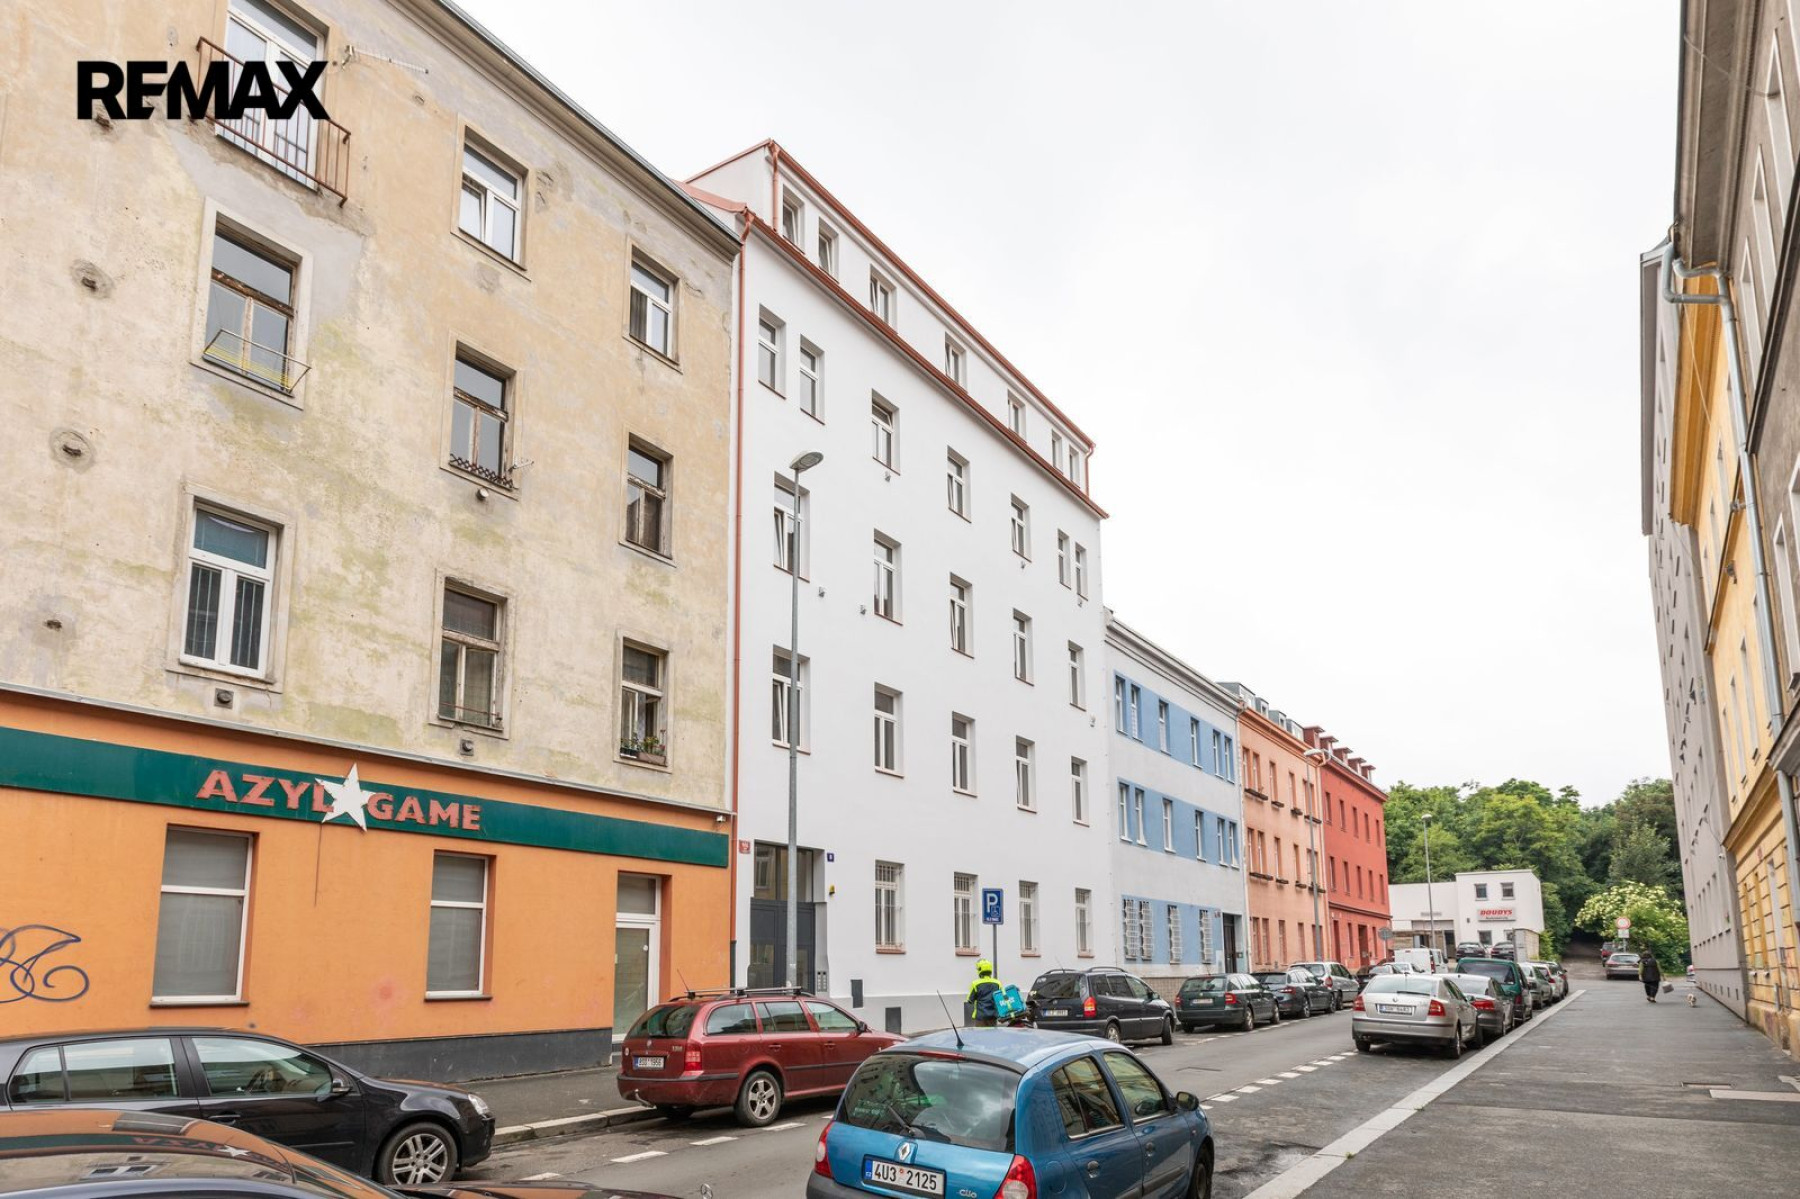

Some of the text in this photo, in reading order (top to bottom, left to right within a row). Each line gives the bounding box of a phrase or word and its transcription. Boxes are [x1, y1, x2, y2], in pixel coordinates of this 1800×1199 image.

[196, 769, 481, 831] AZYL GAME
[986, 893, 998, 913] P
[874, 1163, 937, 1191] 4U3 2125
